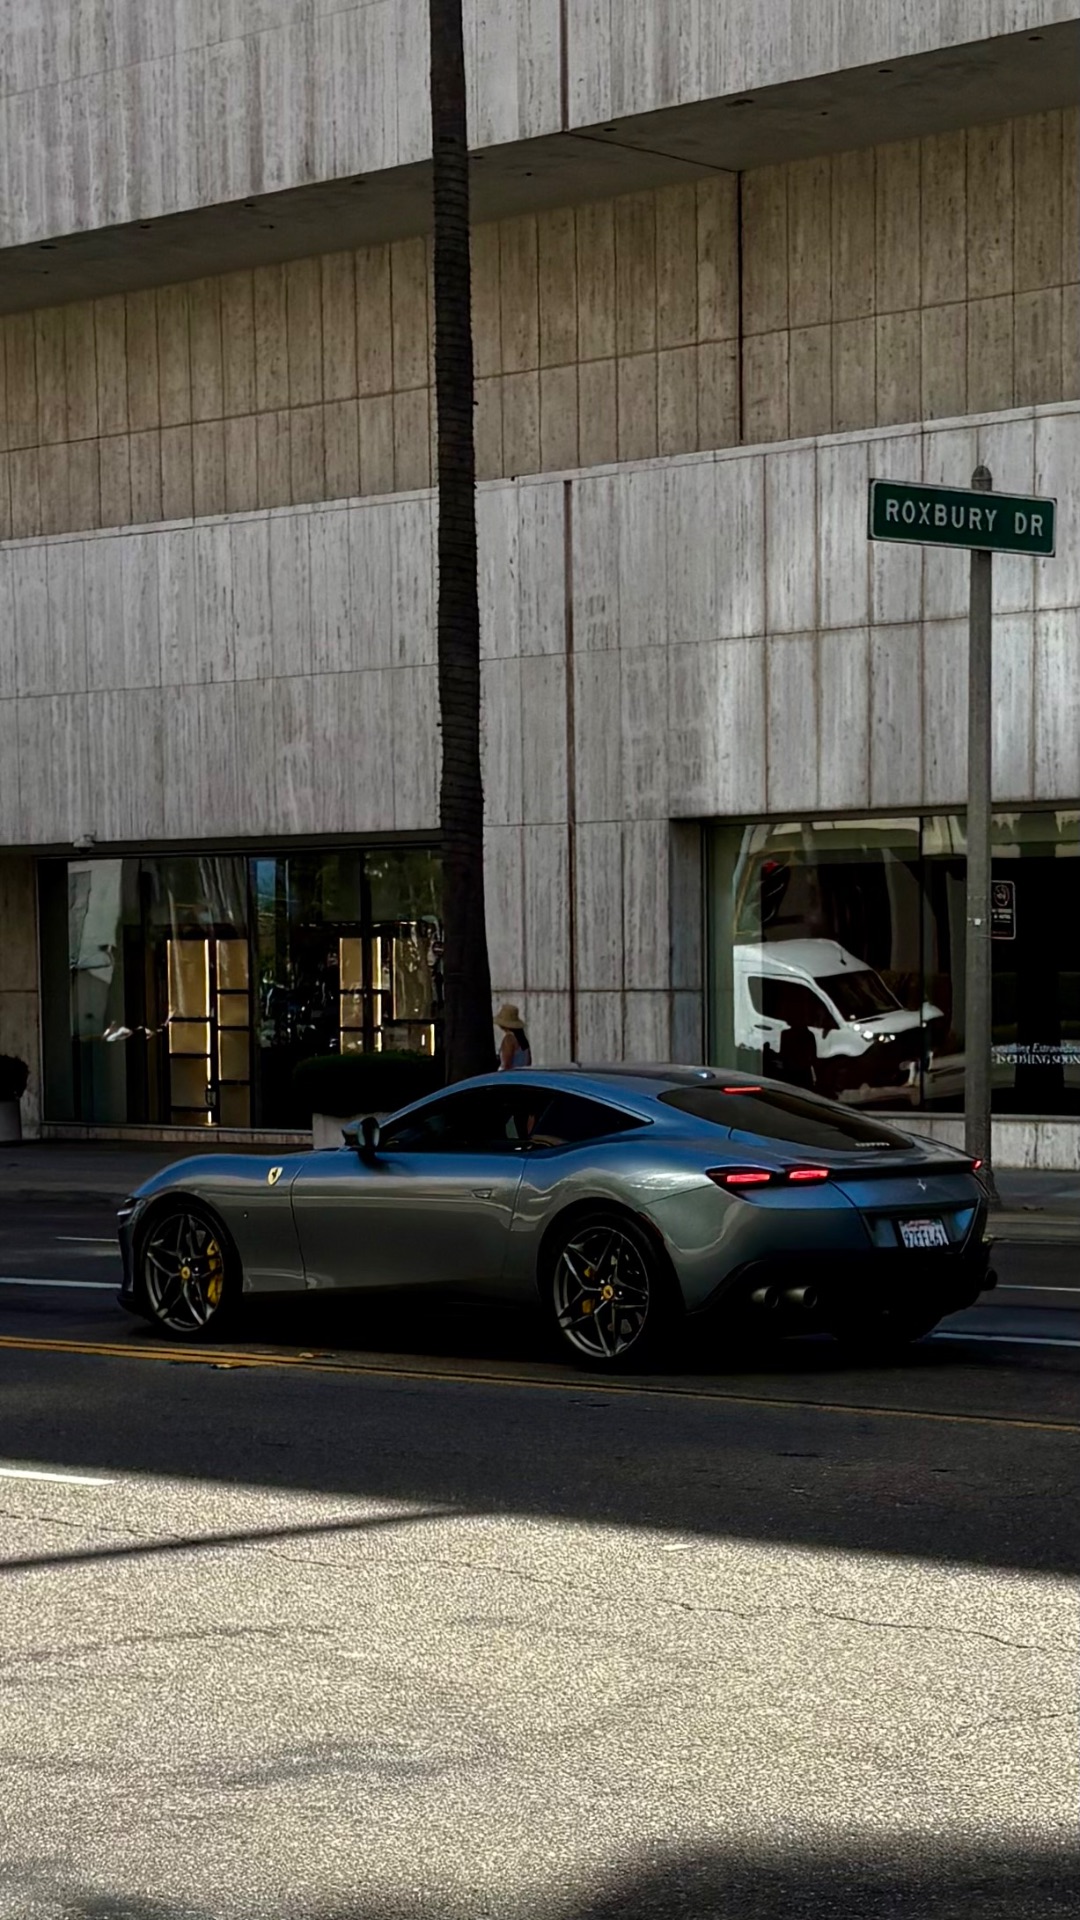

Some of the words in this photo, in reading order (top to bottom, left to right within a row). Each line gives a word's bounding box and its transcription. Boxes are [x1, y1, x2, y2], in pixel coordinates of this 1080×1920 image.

[886, 499, 997, 532] ROXBURY
[1015, 512, 1043, 537] DR
[1007, 1054, 1051, 1064] COMING
